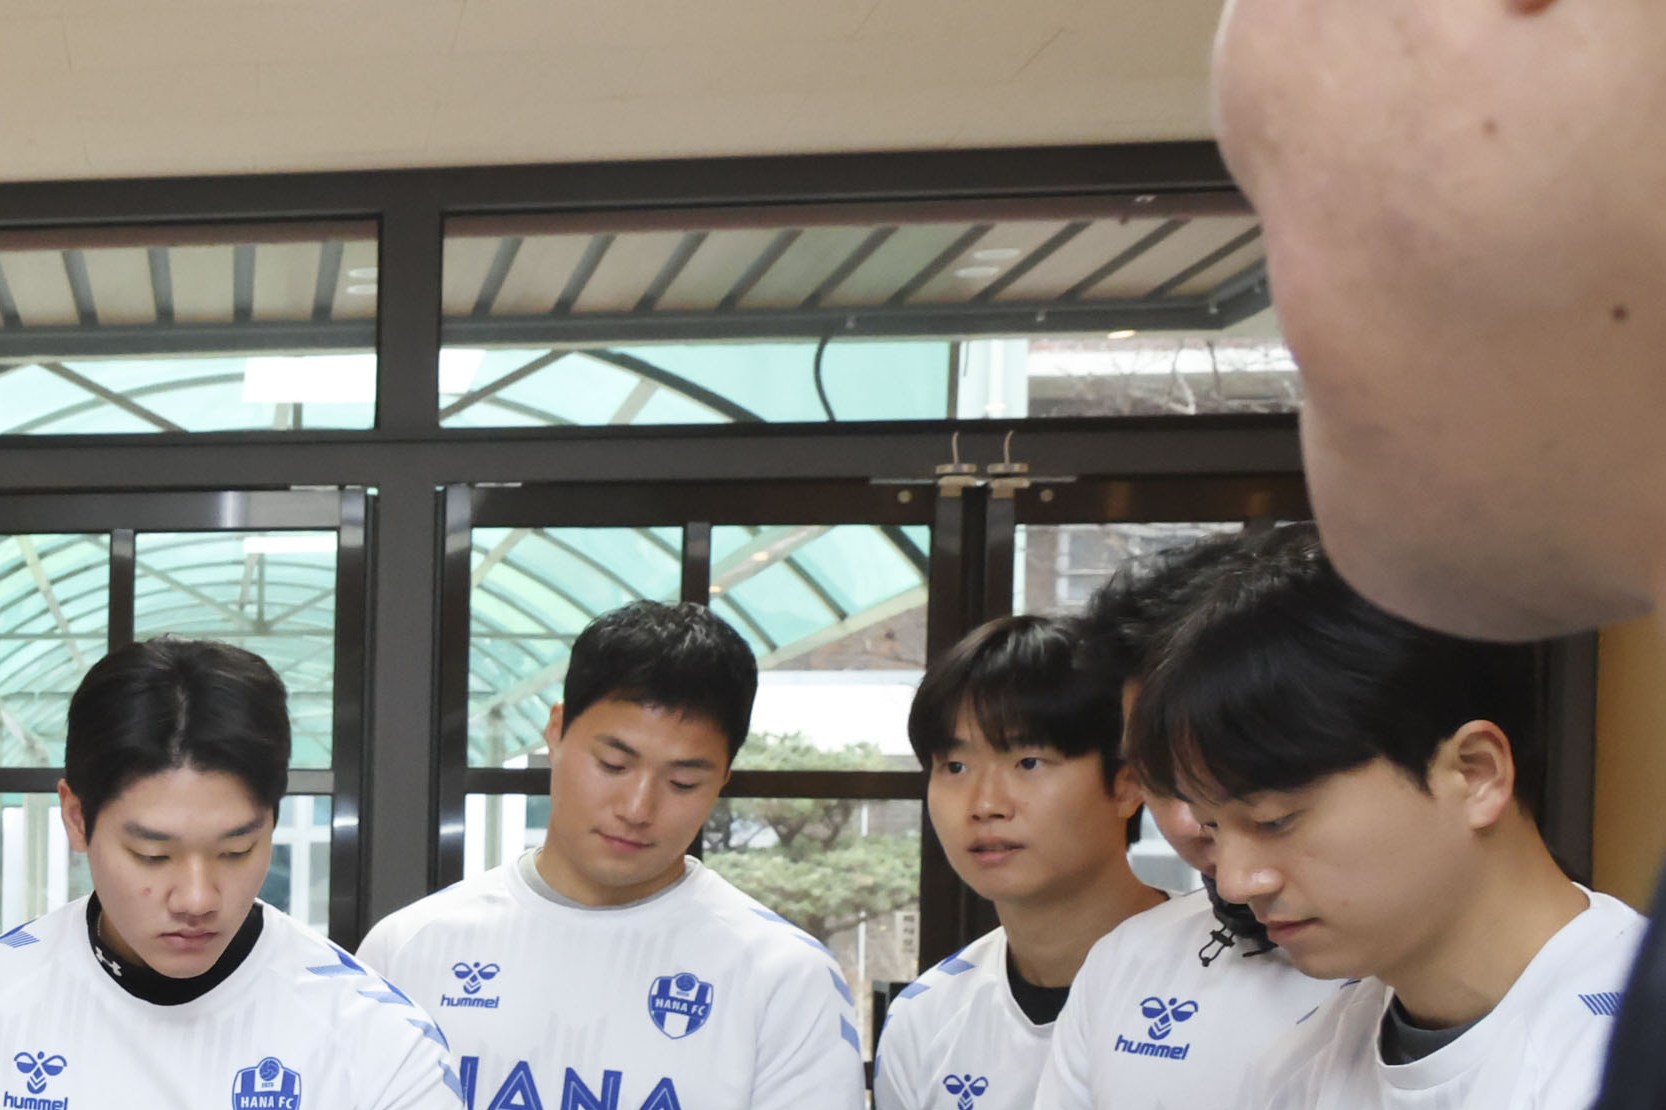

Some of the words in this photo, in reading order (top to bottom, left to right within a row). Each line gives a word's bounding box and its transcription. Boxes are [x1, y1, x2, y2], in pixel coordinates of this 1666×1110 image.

[440, 994, 500, 1009] hummel
[655, 998, 688, 1012] HANA
[691, 1004, 706, 1016] FC
[1114, 1035, 1190, 1060] hummel
[240, 1096, 275, 1109] HANA
[278, 1096, 294, 1109] FC
